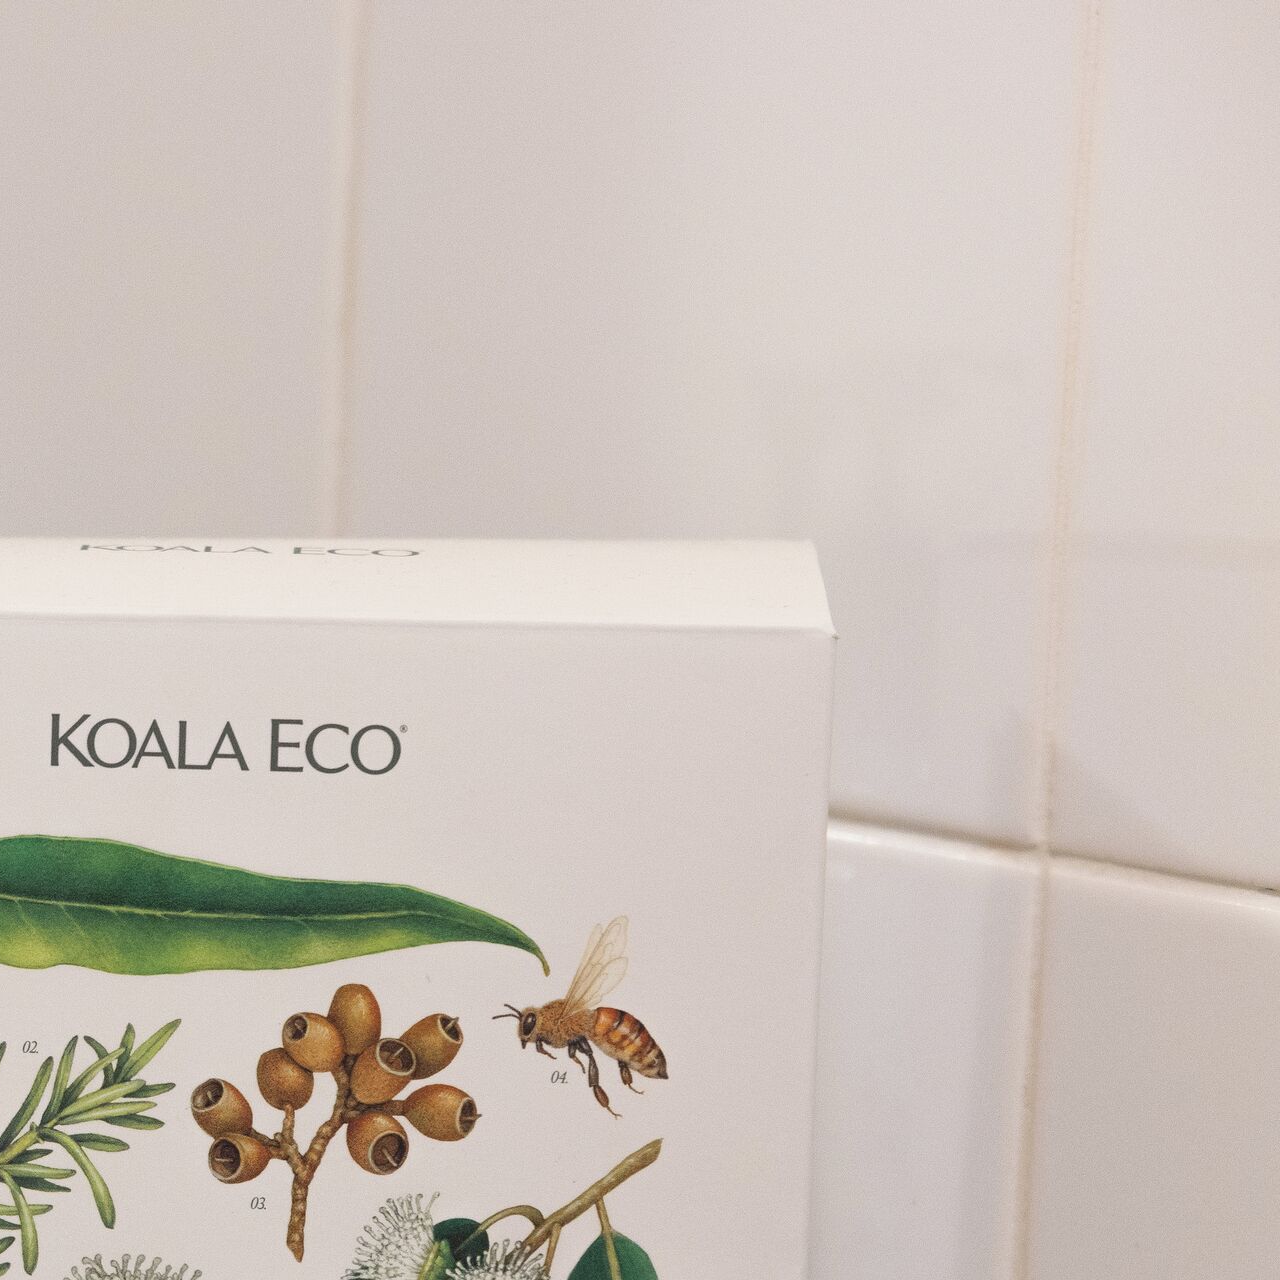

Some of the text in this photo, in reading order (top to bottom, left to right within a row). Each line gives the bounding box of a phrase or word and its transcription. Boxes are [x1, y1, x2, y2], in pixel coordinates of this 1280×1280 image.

[79, 544, 420, 557] KOALA ECO
[50, 713, 250, 771] KOALA
[22, 1040, 39, 1054] 02.
[550, 1070, 569, 1084] 04.
[250, 1196, 267, 1210] 03.
